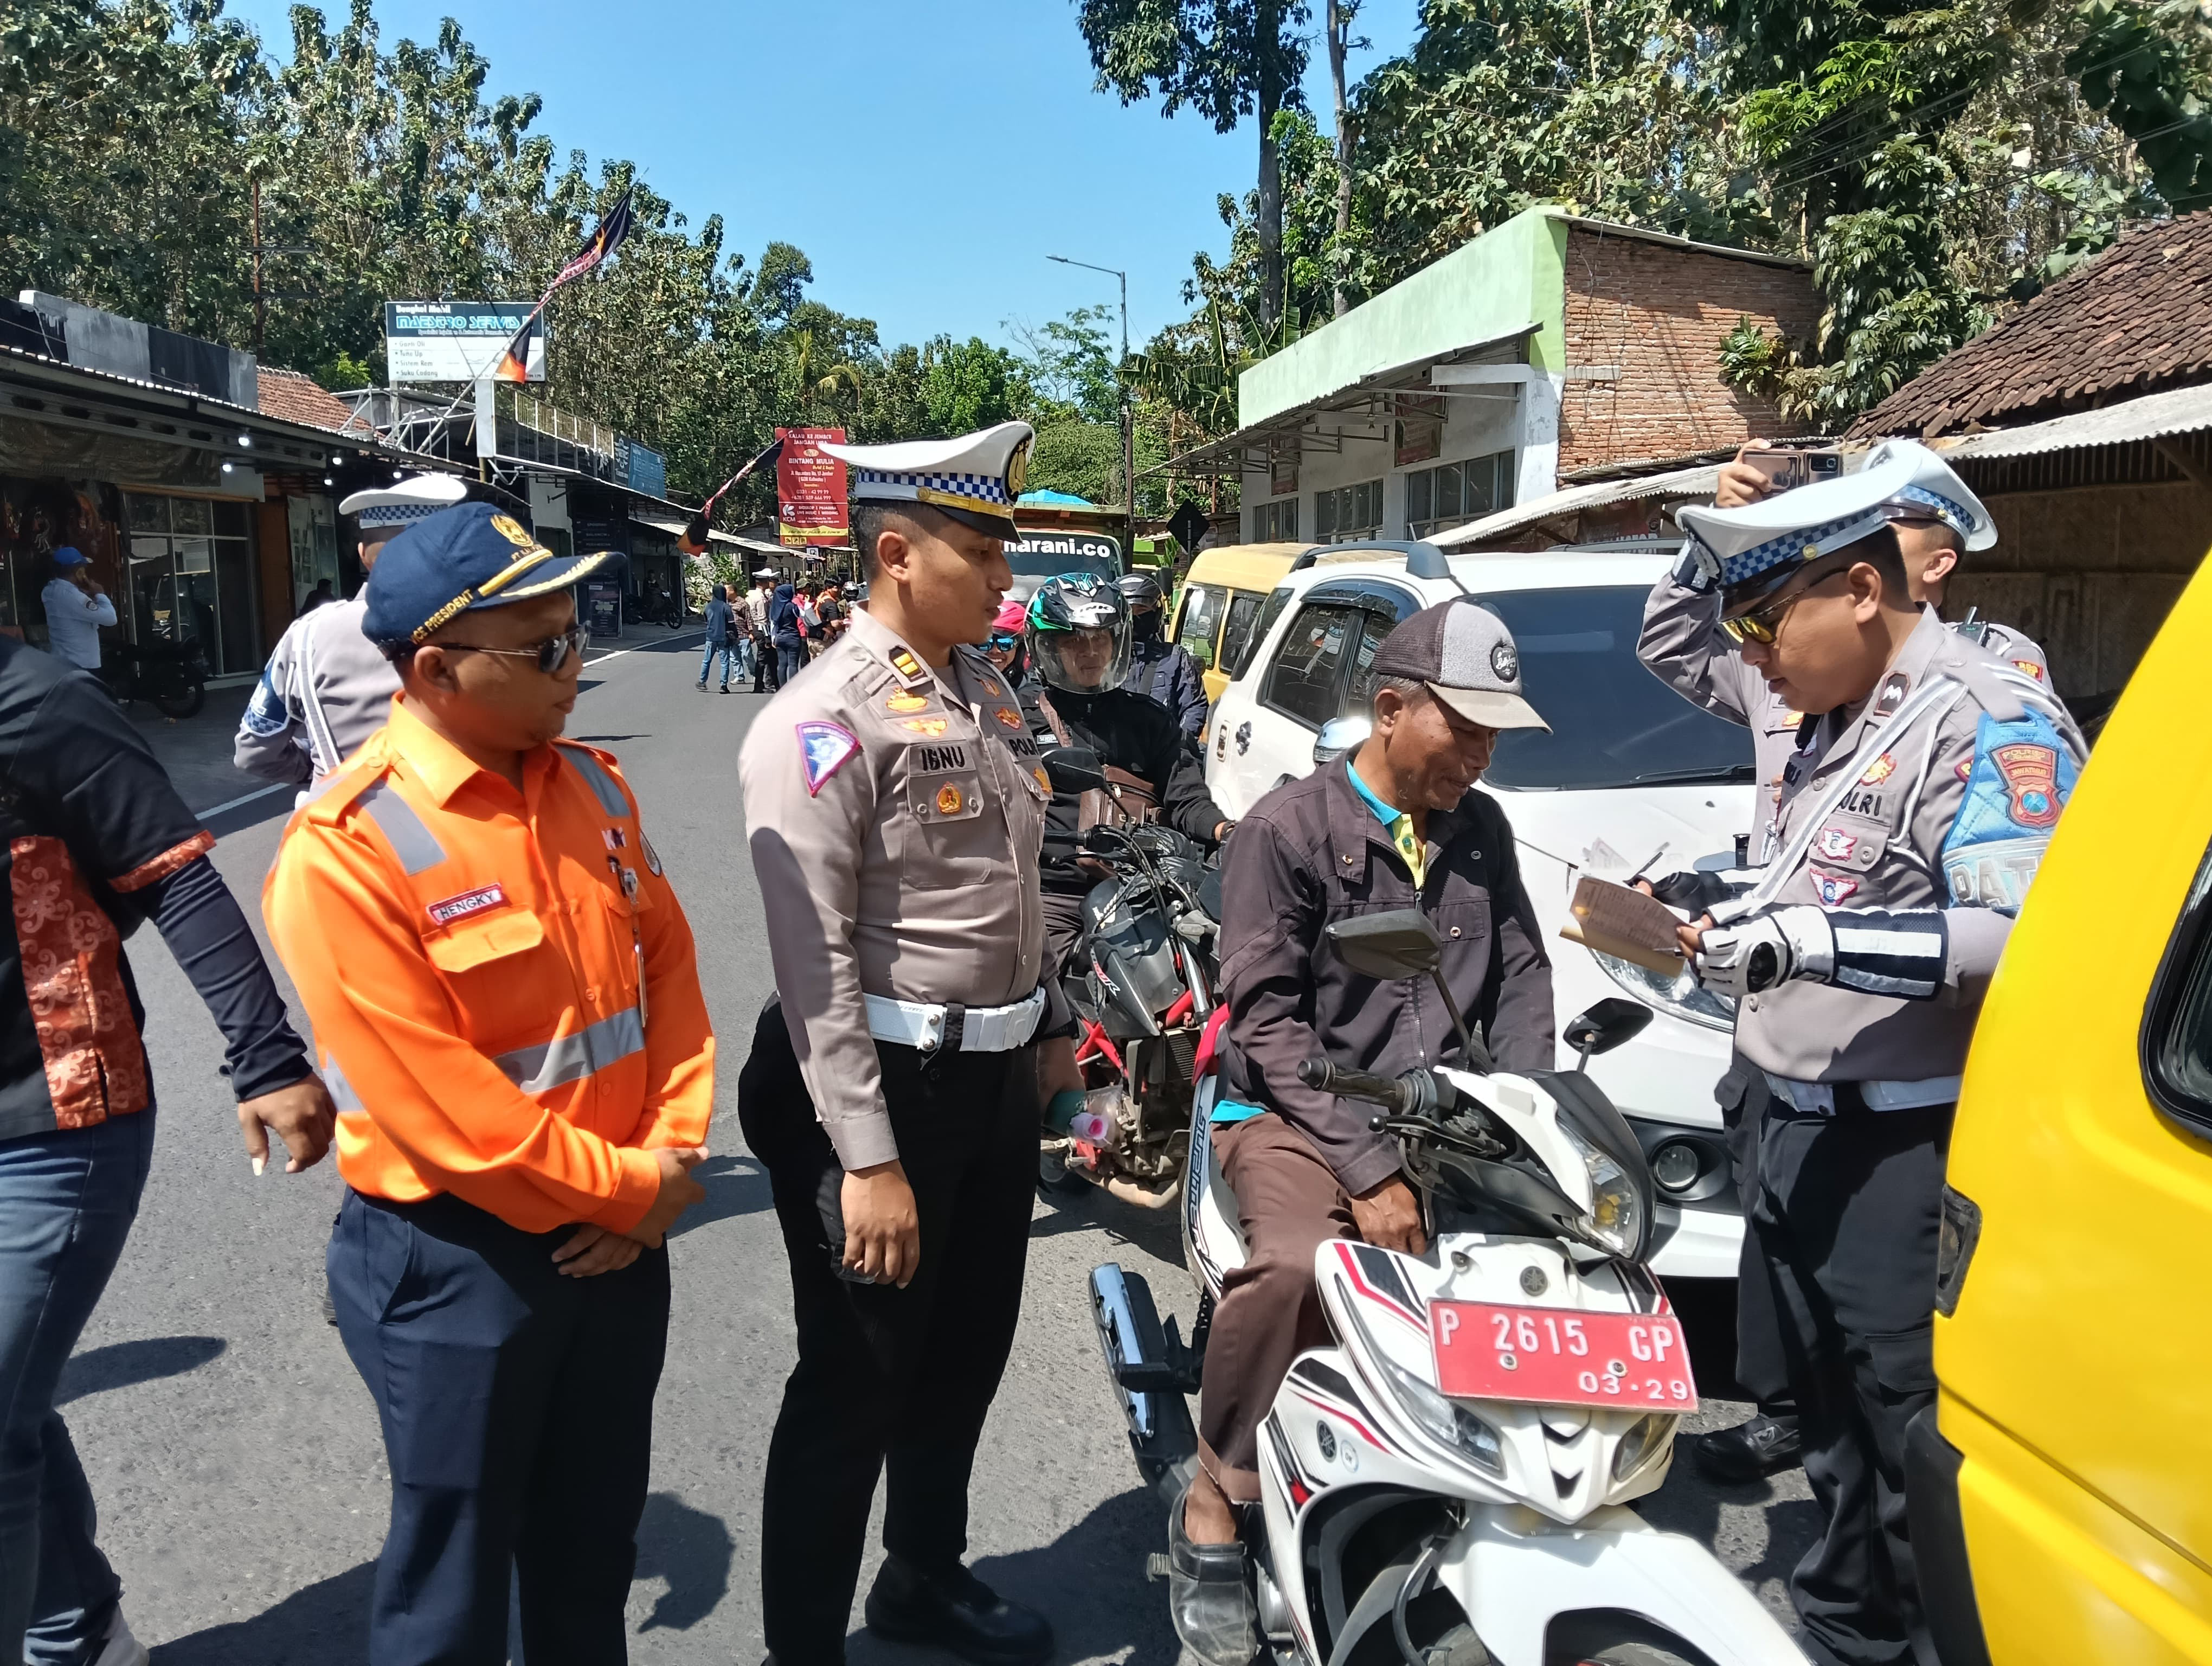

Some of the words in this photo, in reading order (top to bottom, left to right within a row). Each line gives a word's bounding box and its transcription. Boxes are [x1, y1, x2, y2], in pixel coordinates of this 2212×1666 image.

[408, 626, 428, 645] VICE
[424, 589, 473, 632] PRESIDENT
[922, 746, 965, 771] IBNU
[439, 892, 494, 919] HENGKY
[1439, 1308, 1460, 1345] P
[1492, 1313, 1589, 1356] 2615
[1629, 1325, 1674, 1362] GP
